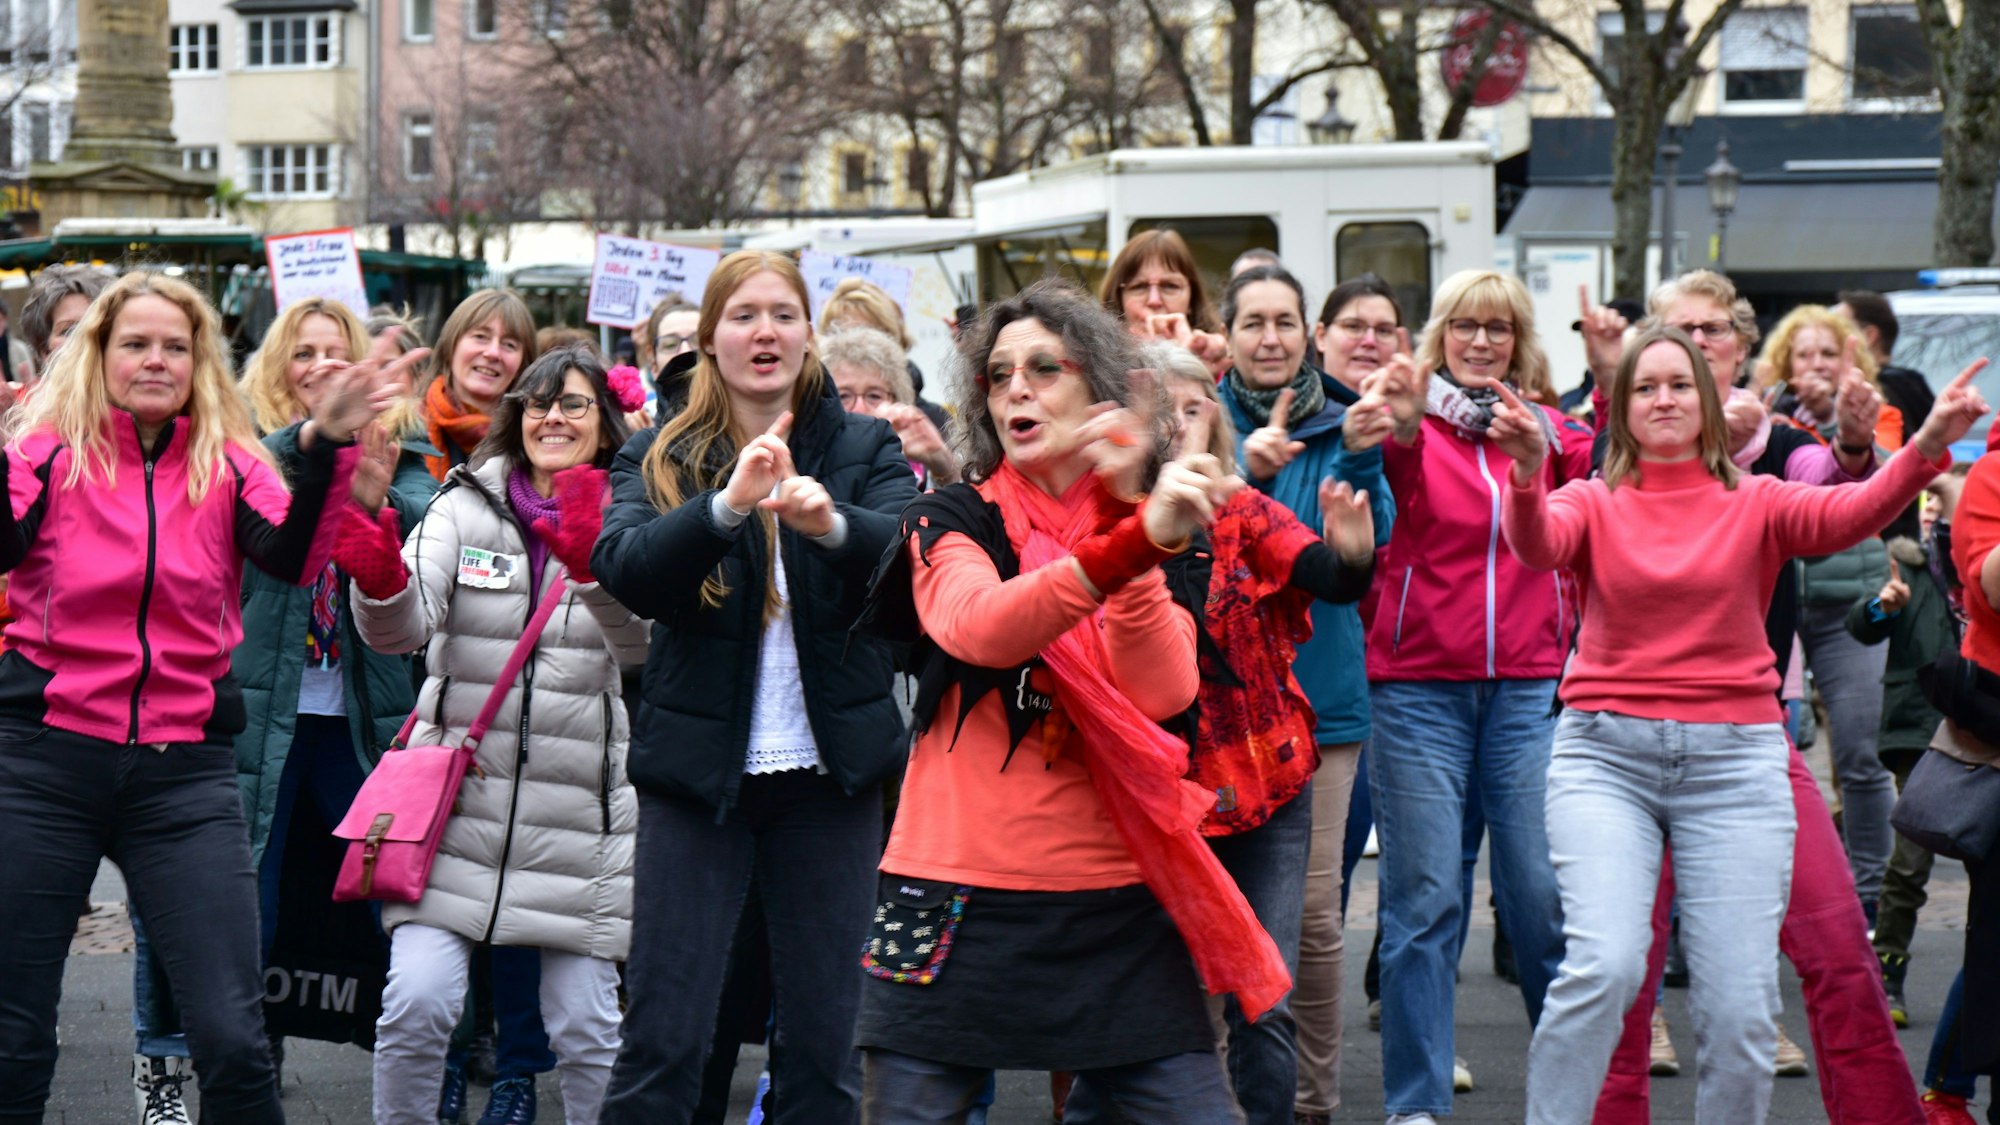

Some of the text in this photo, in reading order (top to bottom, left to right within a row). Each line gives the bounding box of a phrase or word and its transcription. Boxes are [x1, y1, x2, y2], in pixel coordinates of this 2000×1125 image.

[607, 241, 643, 258] Jeden
[665, 250, 684, 268] Tag
[464, 548, 491, 560] WOMEN
[463, 557, 480, 567] LIFE
[462, 566, 490, 577] FREEDOM
